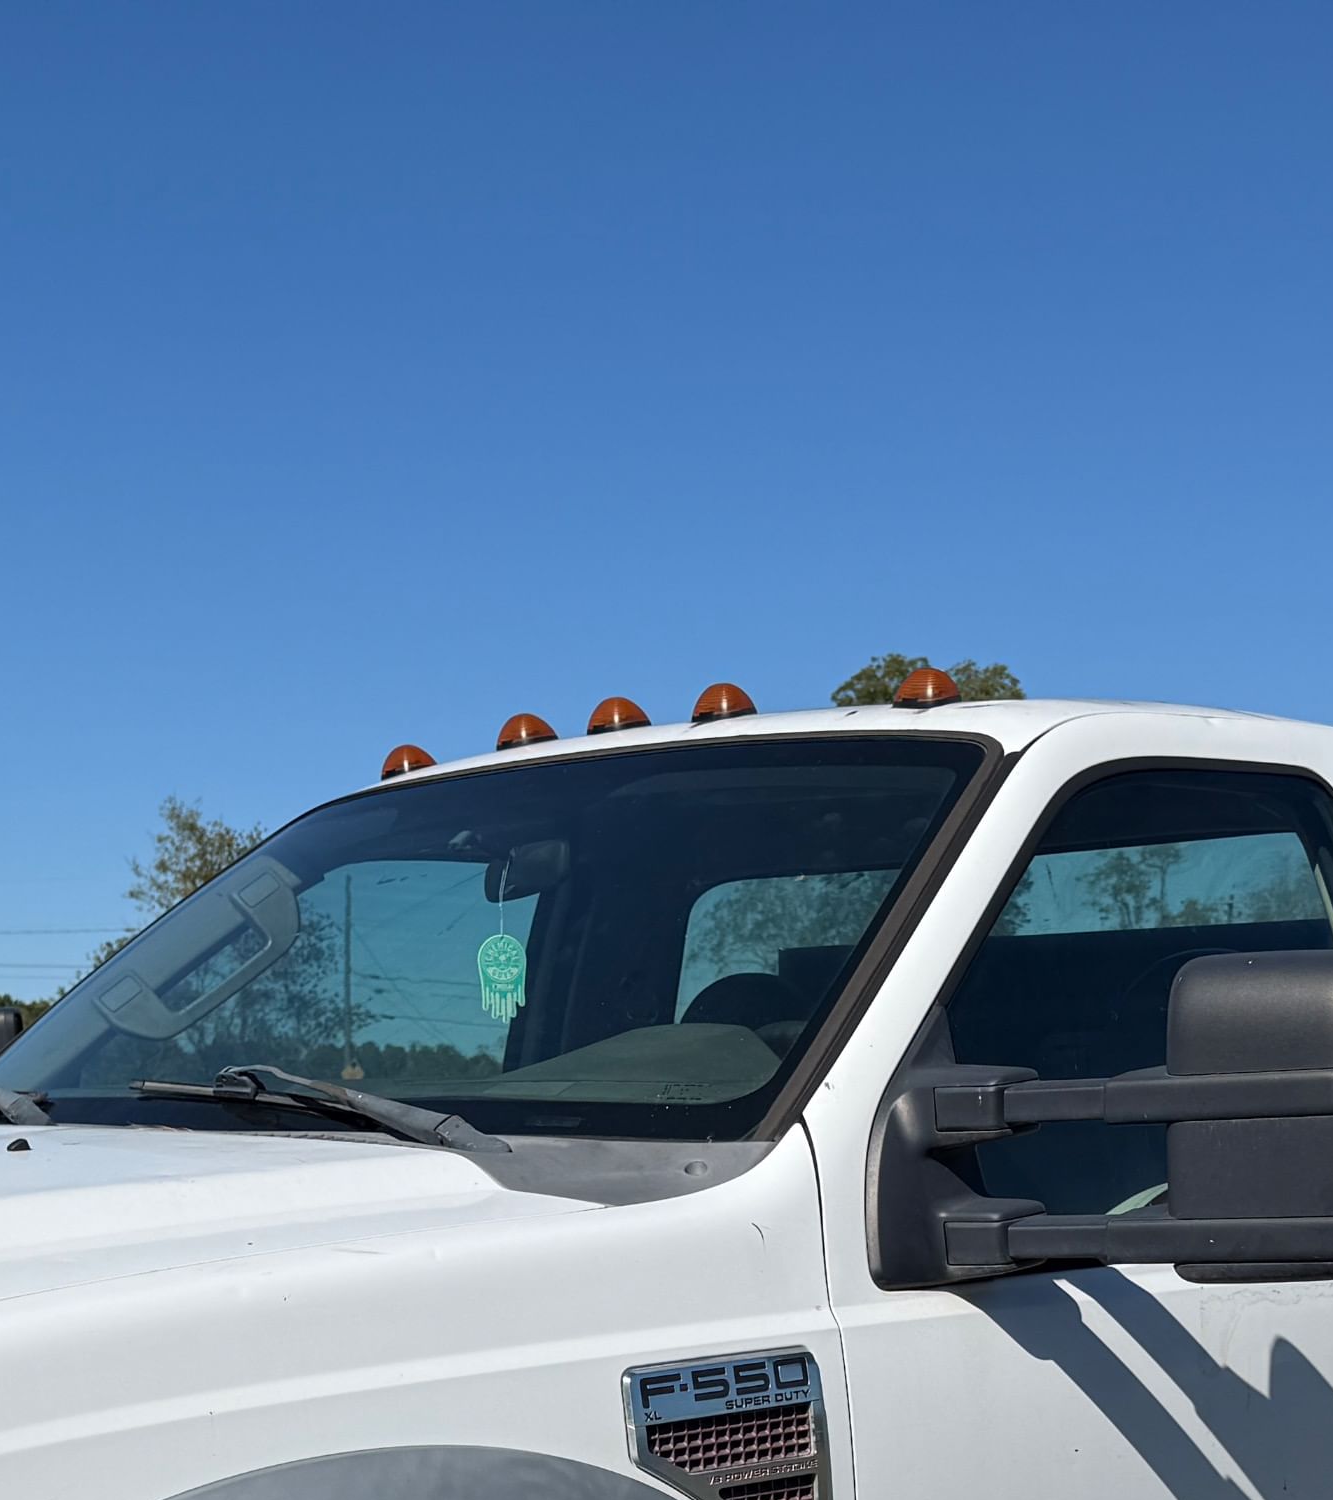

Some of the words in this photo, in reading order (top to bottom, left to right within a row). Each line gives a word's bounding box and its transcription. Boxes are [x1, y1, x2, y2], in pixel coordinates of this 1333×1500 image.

[639, 1356, 810, 1409] F-550
[725, 1394, 771, 1410] SUPER
[774, 1388, 811, 1402] DUTY
[644, 1410, 663, 1423] XL
[726, 1467, 770, 1484] POWER
